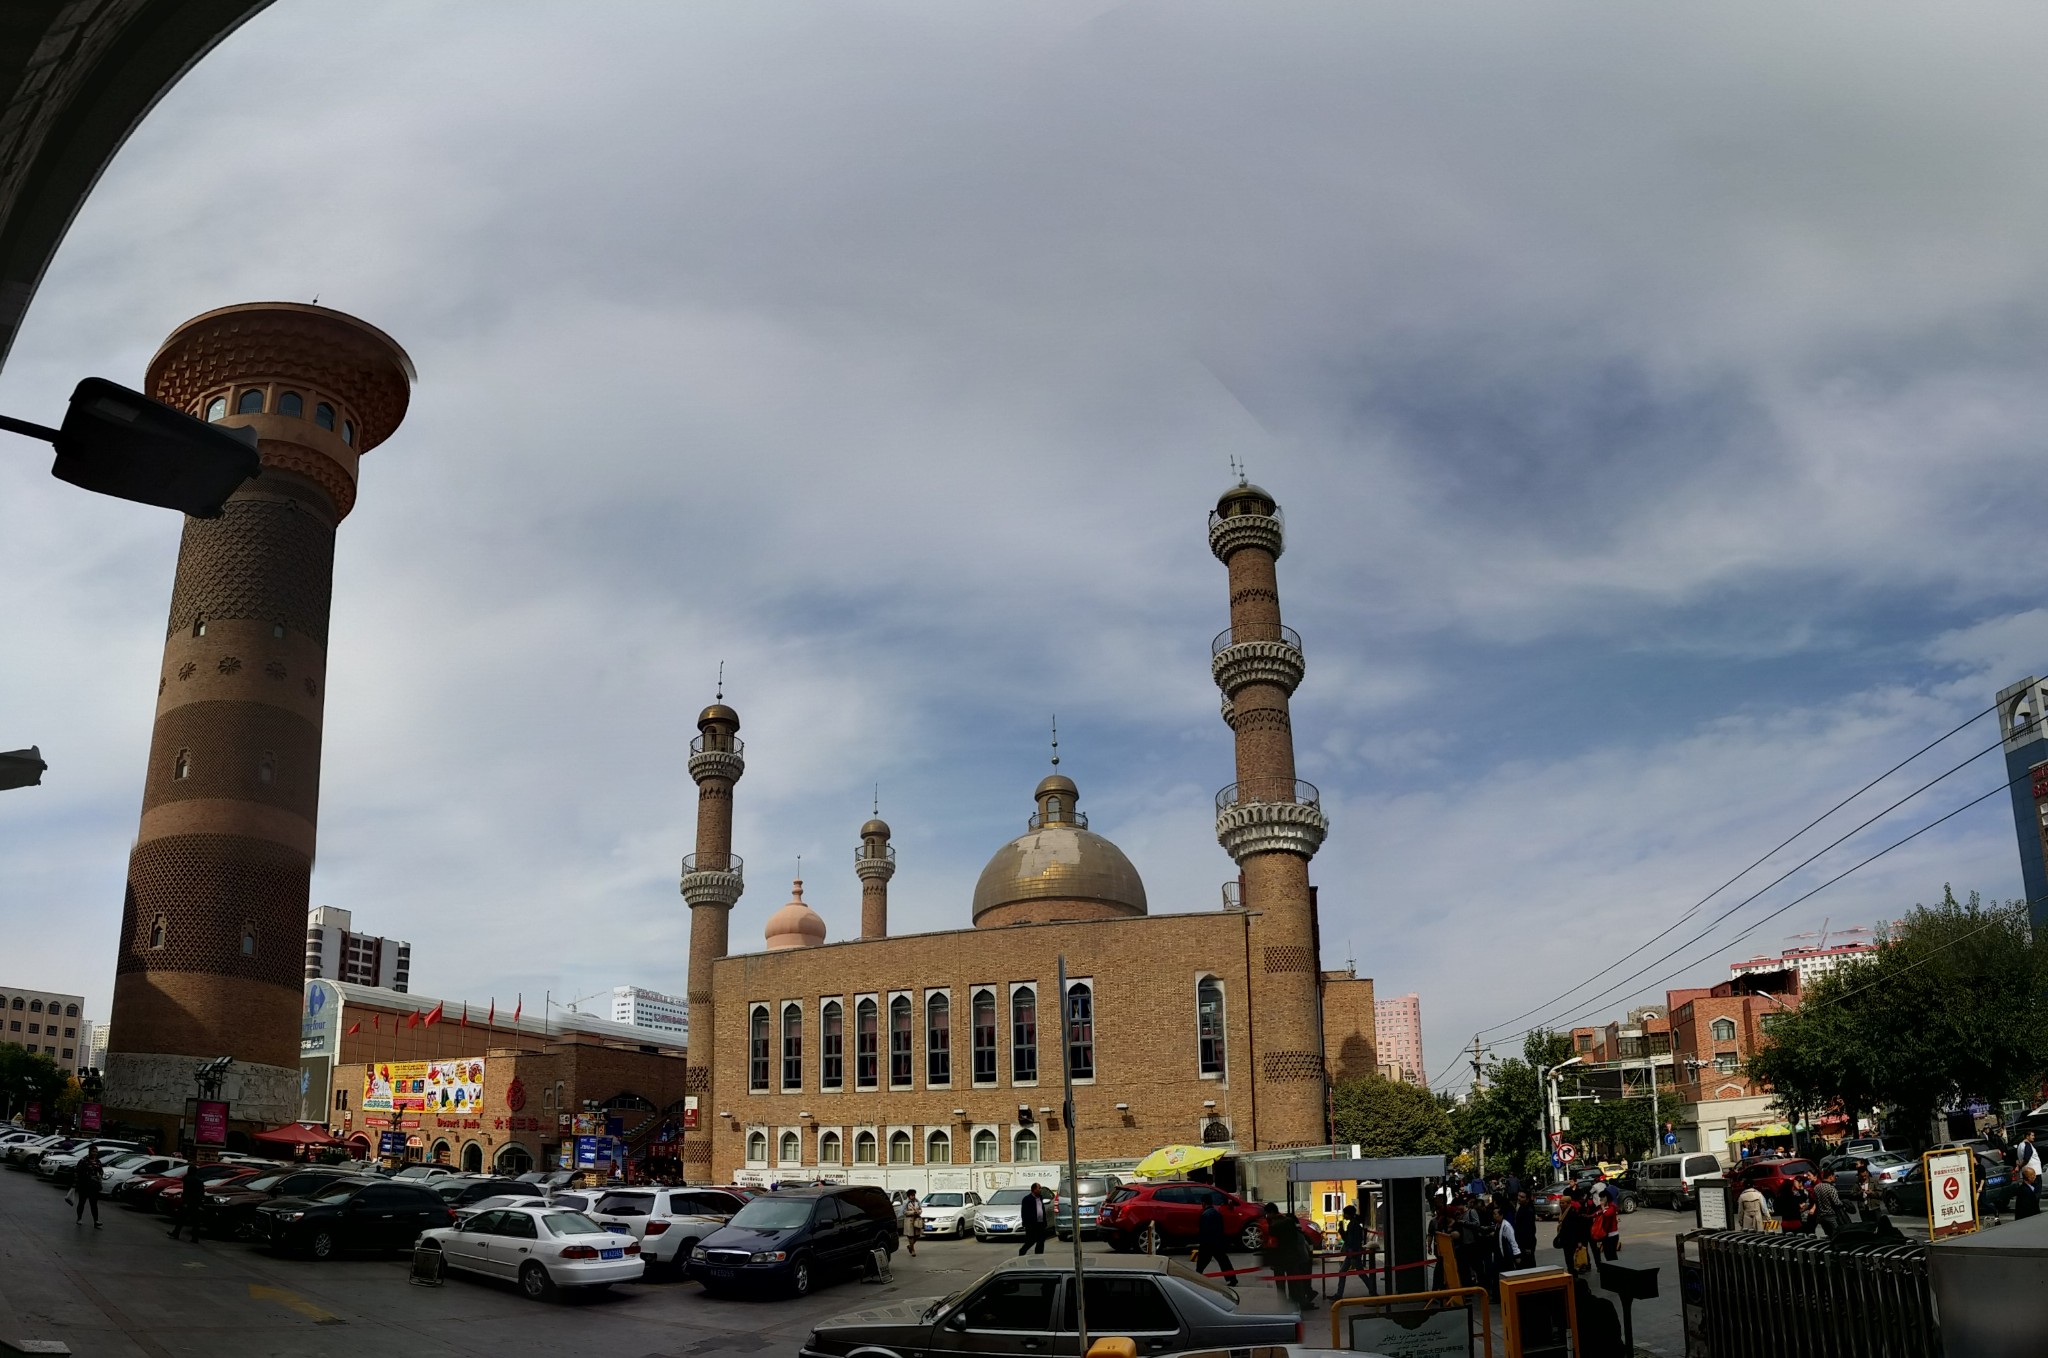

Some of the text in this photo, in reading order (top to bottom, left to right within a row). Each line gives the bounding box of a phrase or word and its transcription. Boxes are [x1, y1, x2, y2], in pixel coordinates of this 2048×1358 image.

[437, 1118, 480, 1129] Desert Jade
[1941, 1205, 1965, 1217] 车辆入口
